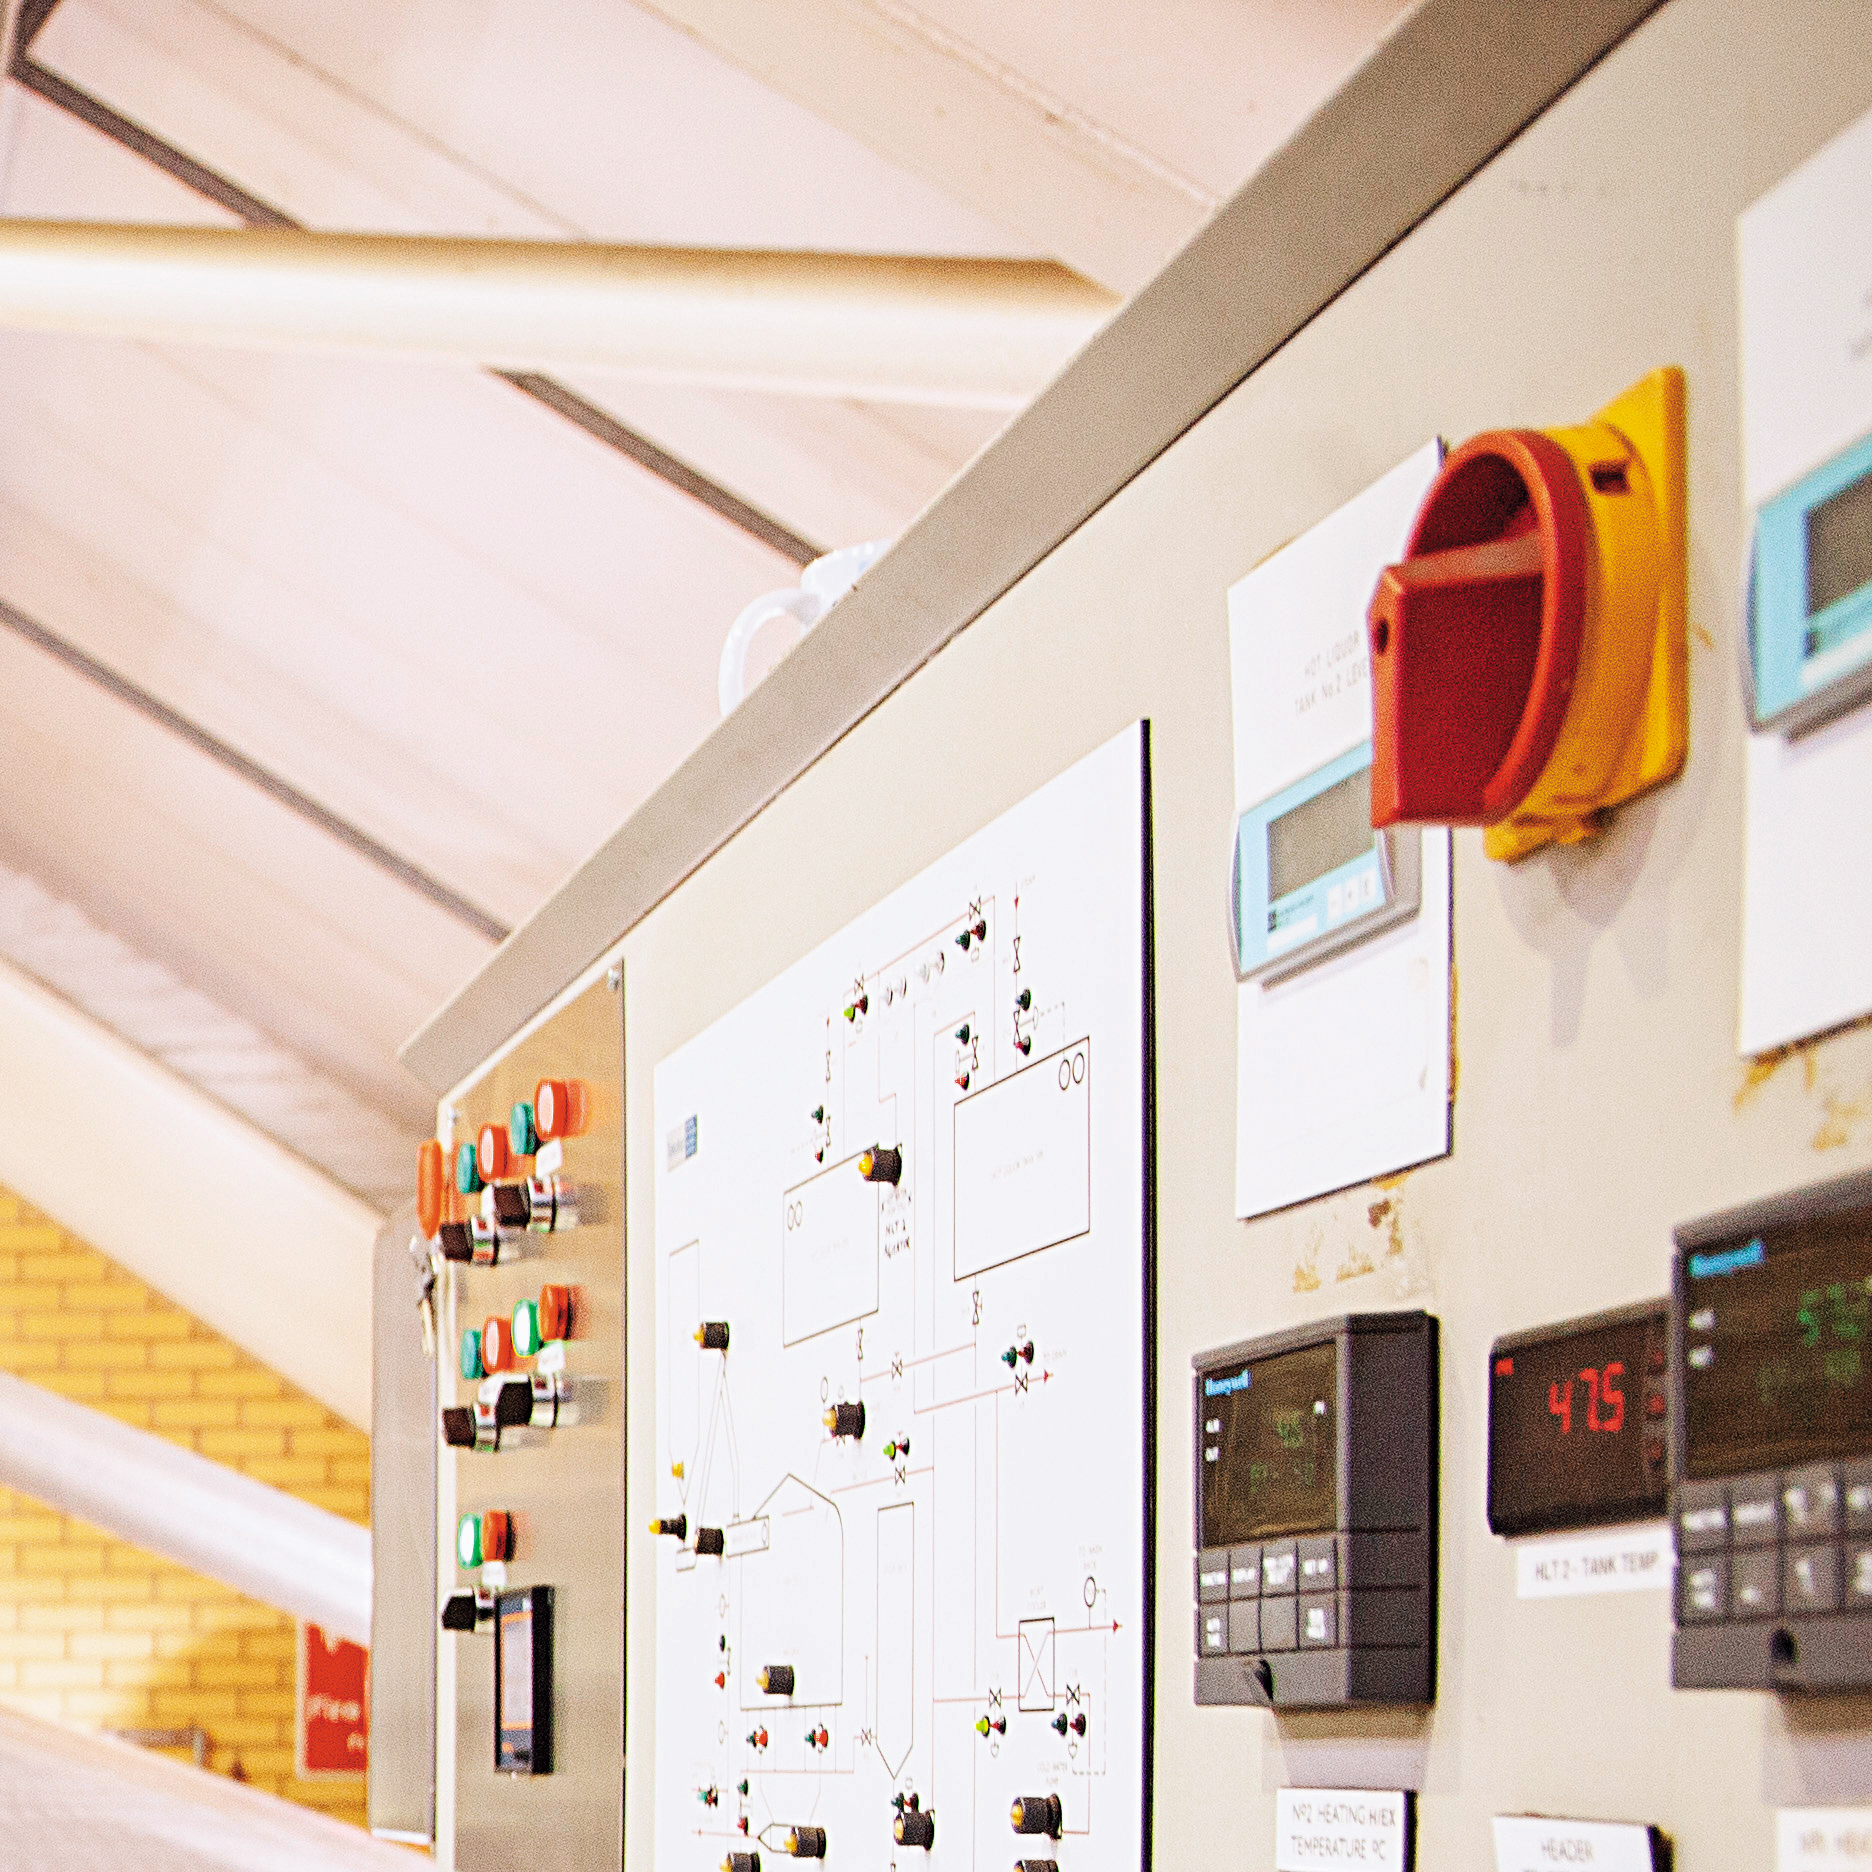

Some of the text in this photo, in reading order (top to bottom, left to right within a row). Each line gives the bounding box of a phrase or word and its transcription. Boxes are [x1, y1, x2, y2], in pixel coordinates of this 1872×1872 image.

[1582, 1554, 1617, 1577] TANK
[1318, 1803, 1366, 1825] HEATING
[1290, 1834, 1367, 1860] TEMPERATURE
[1540, 1838, 1594, 1863] HEADER
